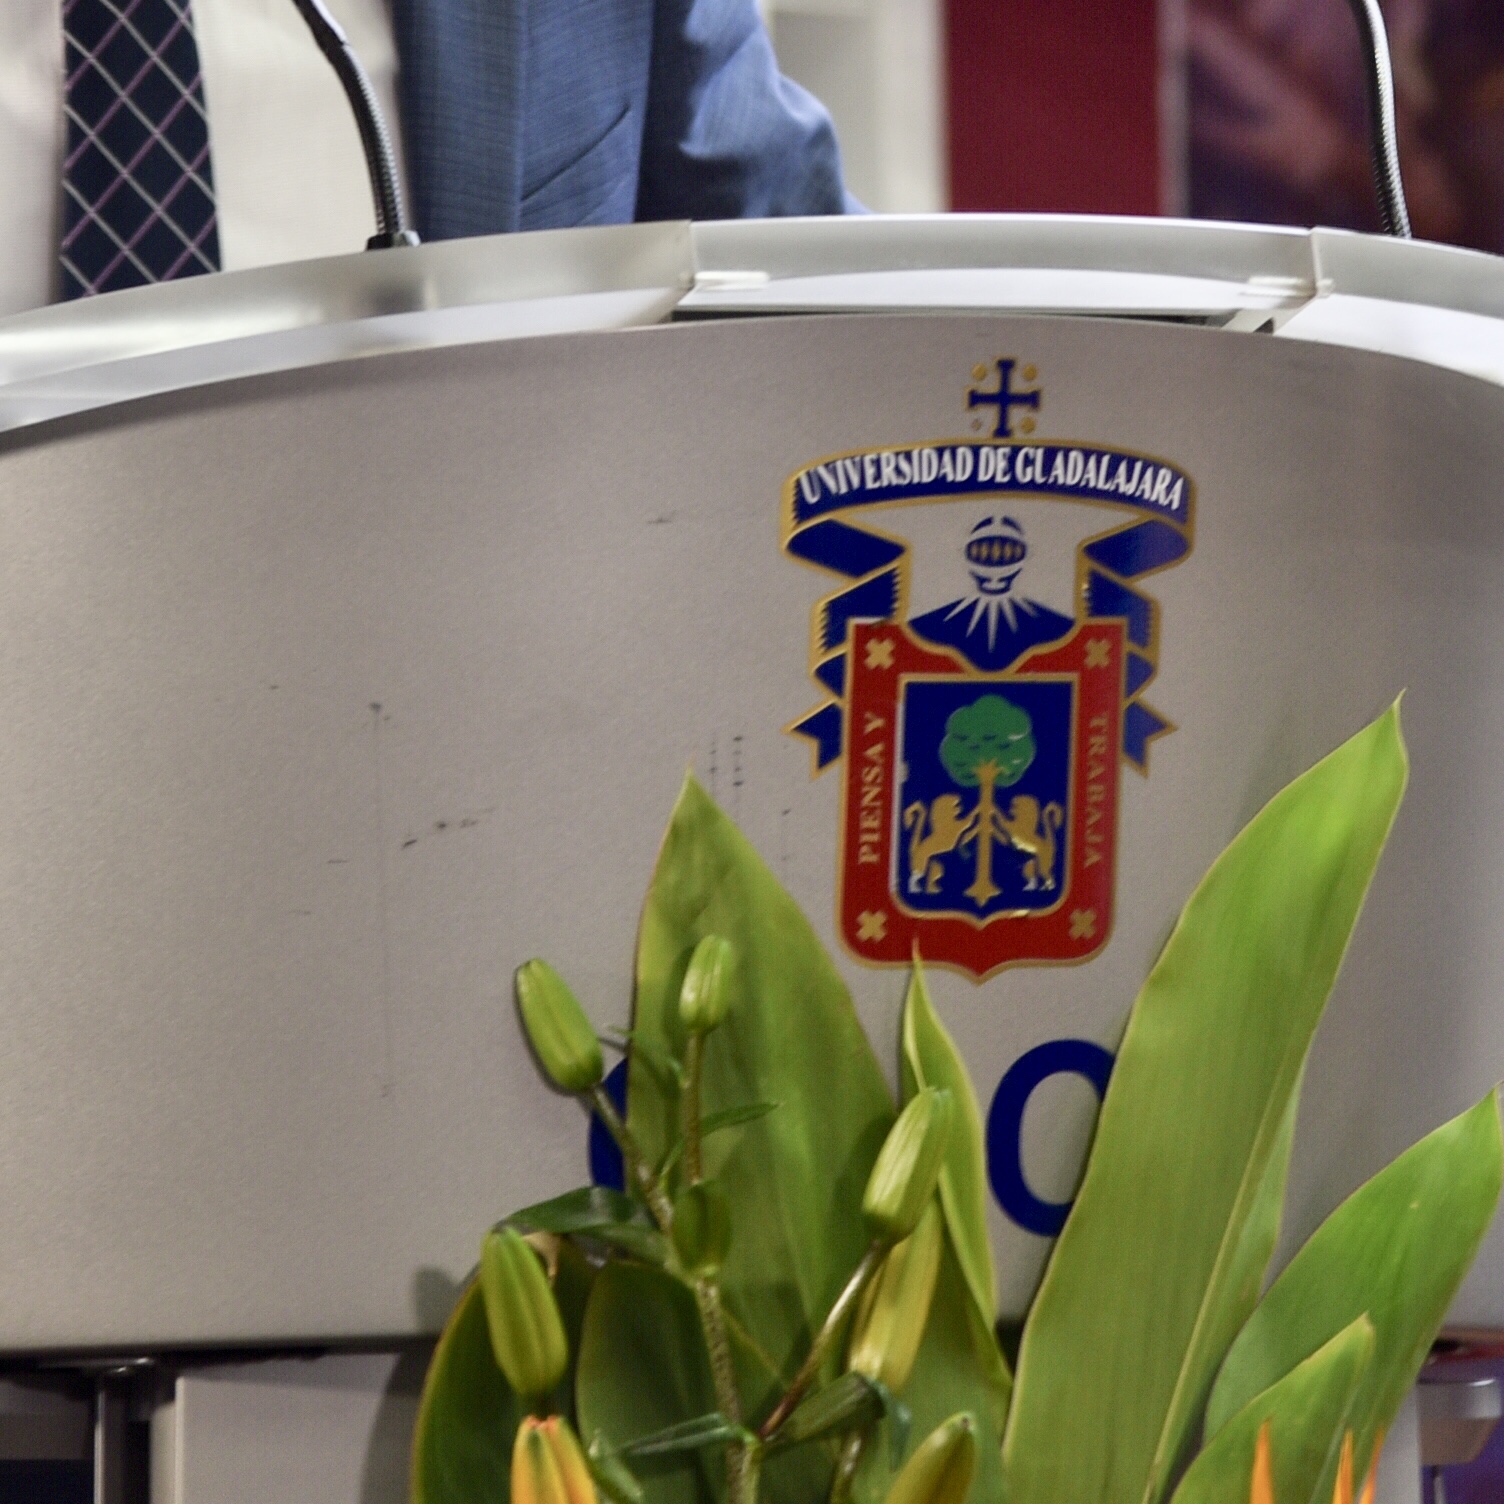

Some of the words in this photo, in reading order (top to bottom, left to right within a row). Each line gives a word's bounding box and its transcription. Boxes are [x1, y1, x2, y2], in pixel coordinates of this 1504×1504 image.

[799, 446, 974, 504] UNIVERSIDAD
[977, 446, 1012, 483] DE
[863, 710, 886, 736] Y
[857, 741, 886, 865] PIENSA
[1083, 711, 1109, 869] TRABAJA
